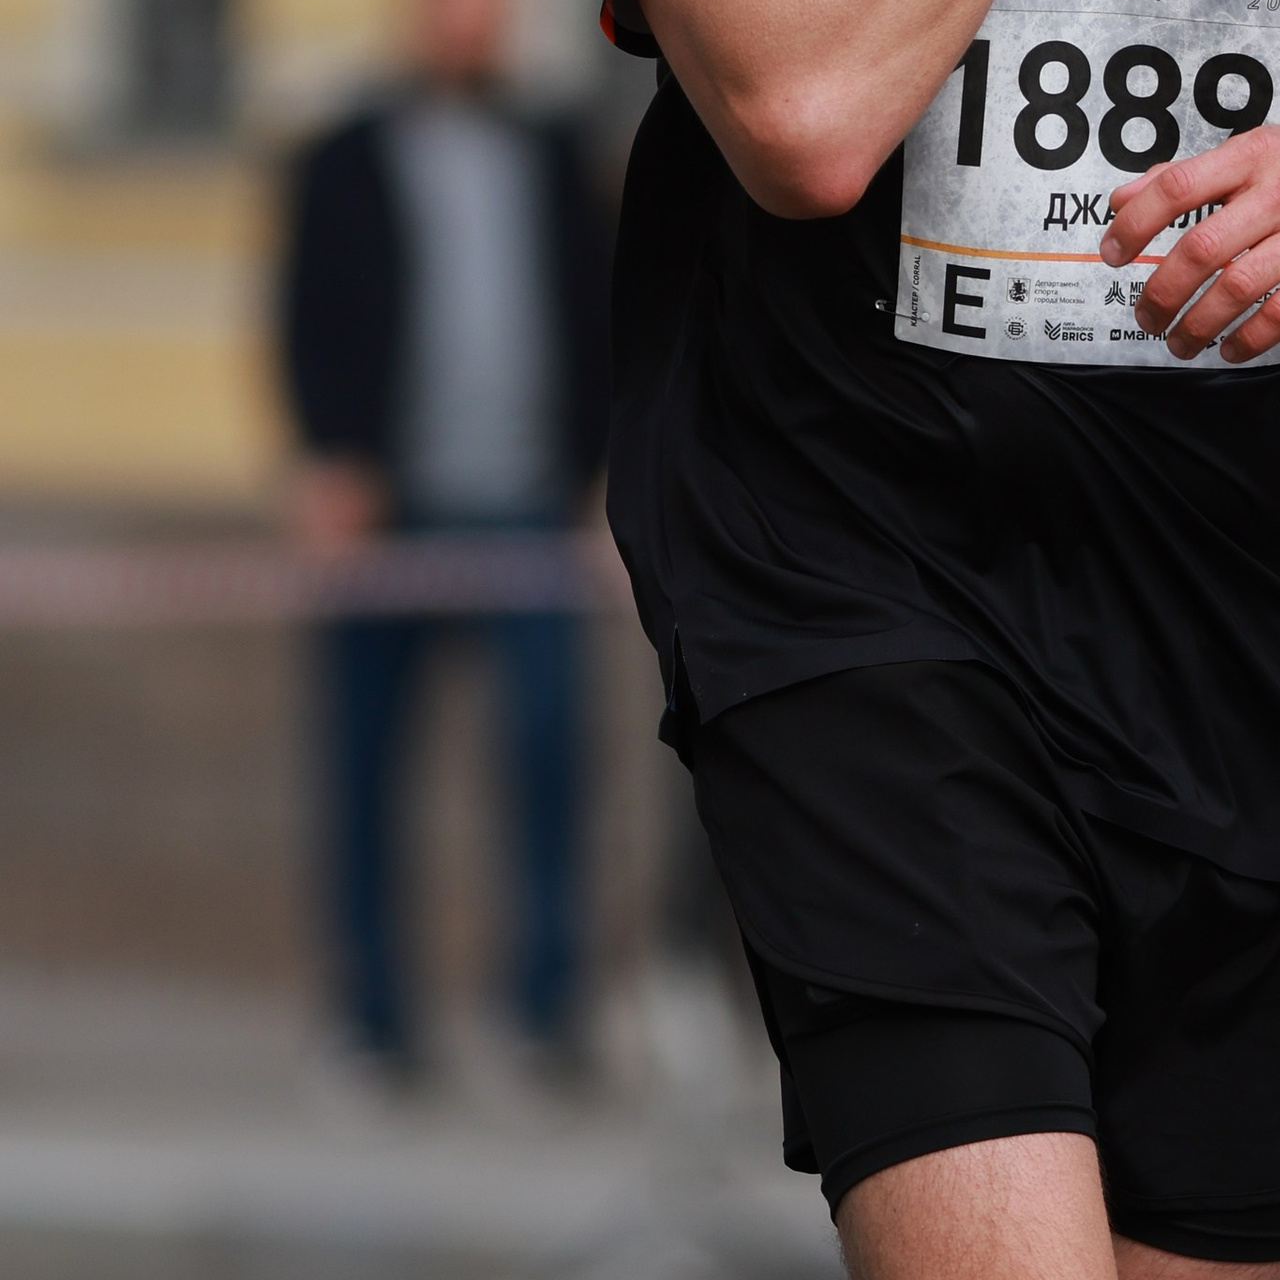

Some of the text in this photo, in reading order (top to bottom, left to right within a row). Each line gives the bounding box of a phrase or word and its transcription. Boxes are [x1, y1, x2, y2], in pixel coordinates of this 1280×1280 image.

[913, 255, 921, 286] CORRAL
[942, 263, 991, 340] E
[1062, 332, 1094, 342] BRICS
